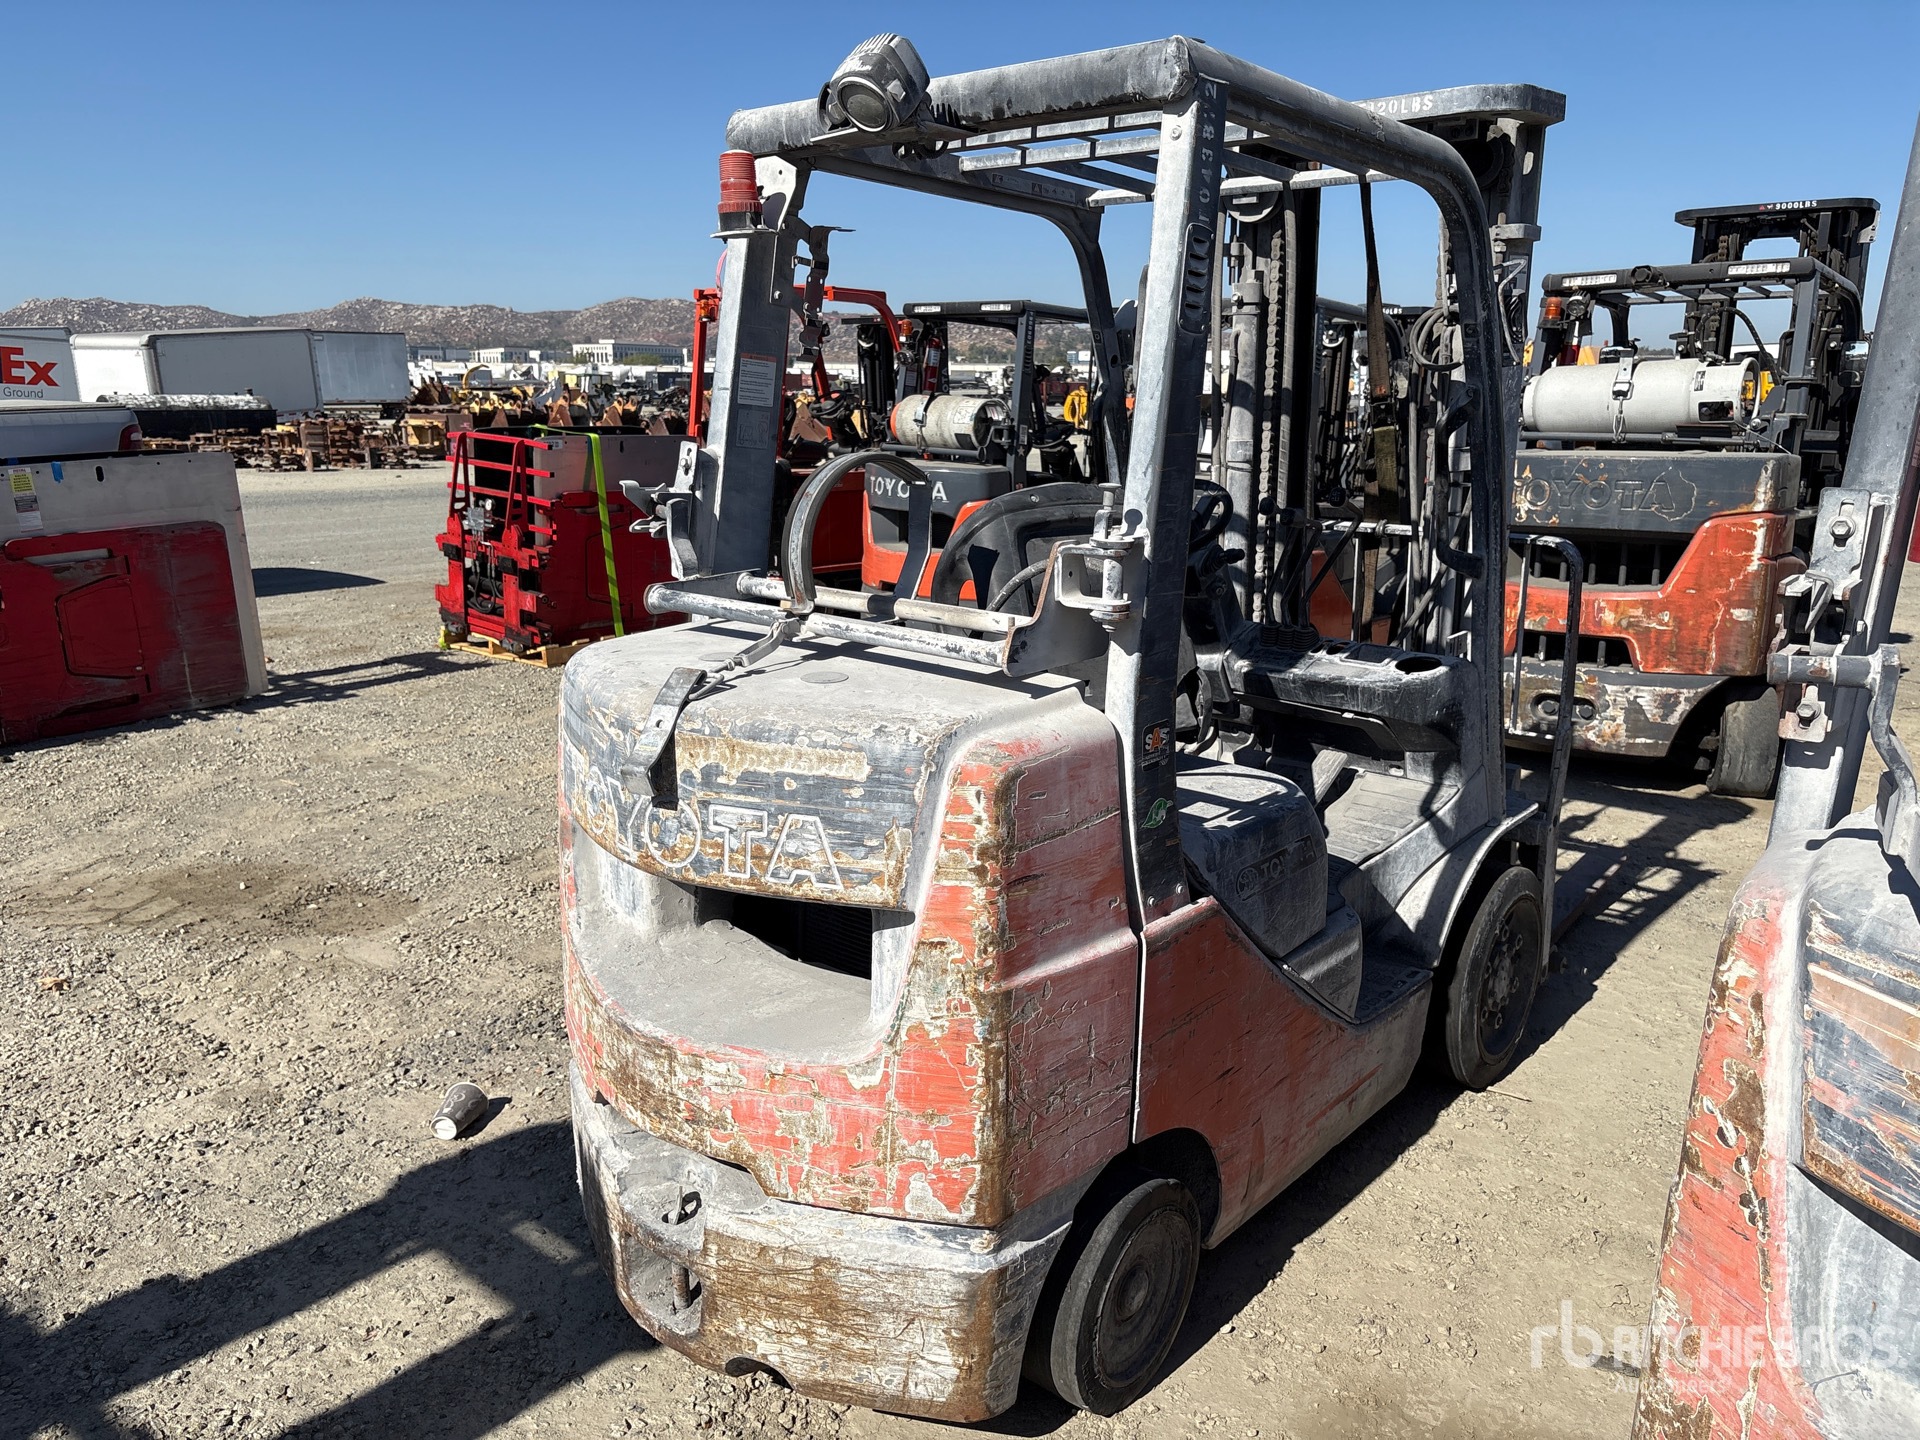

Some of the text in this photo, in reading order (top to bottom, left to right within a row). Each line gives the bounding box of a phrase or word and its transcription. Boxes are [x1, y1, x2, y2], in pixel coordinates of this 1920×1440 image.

[1358, 94, 1434, 116] 120LBS
[1775, 200, 1818, 211] 9000LBS
[0, 346, 60, 387] Ex
[3, 386, 44, 398] Ground
[870, 475, 950, 503] TOYOA
